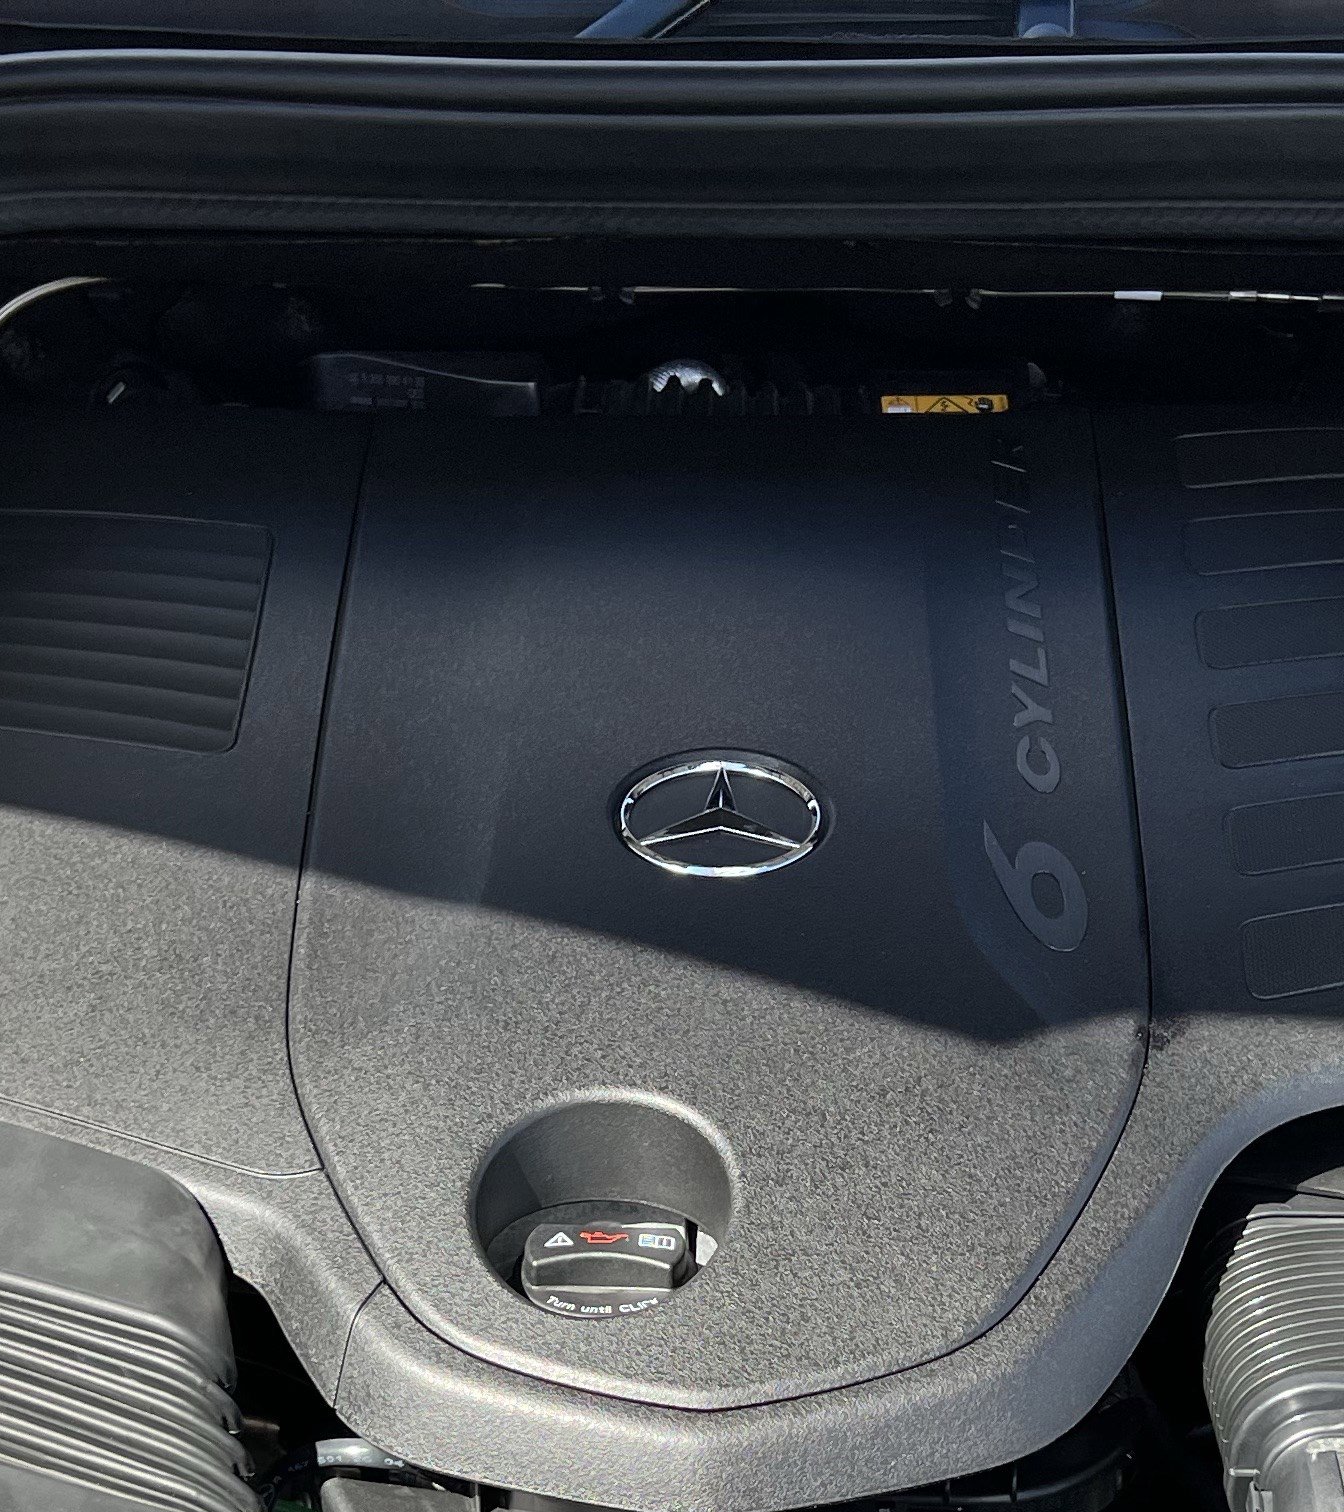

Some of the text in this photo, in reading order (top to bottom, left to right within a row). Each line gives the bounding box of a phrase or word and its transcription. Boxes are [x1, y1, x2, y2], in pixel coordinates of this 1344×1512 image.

[983, 818, 1089, 953] 6
[546, 1295, 576, 1311] Turn
[580, 1305, 612, 1314] until
